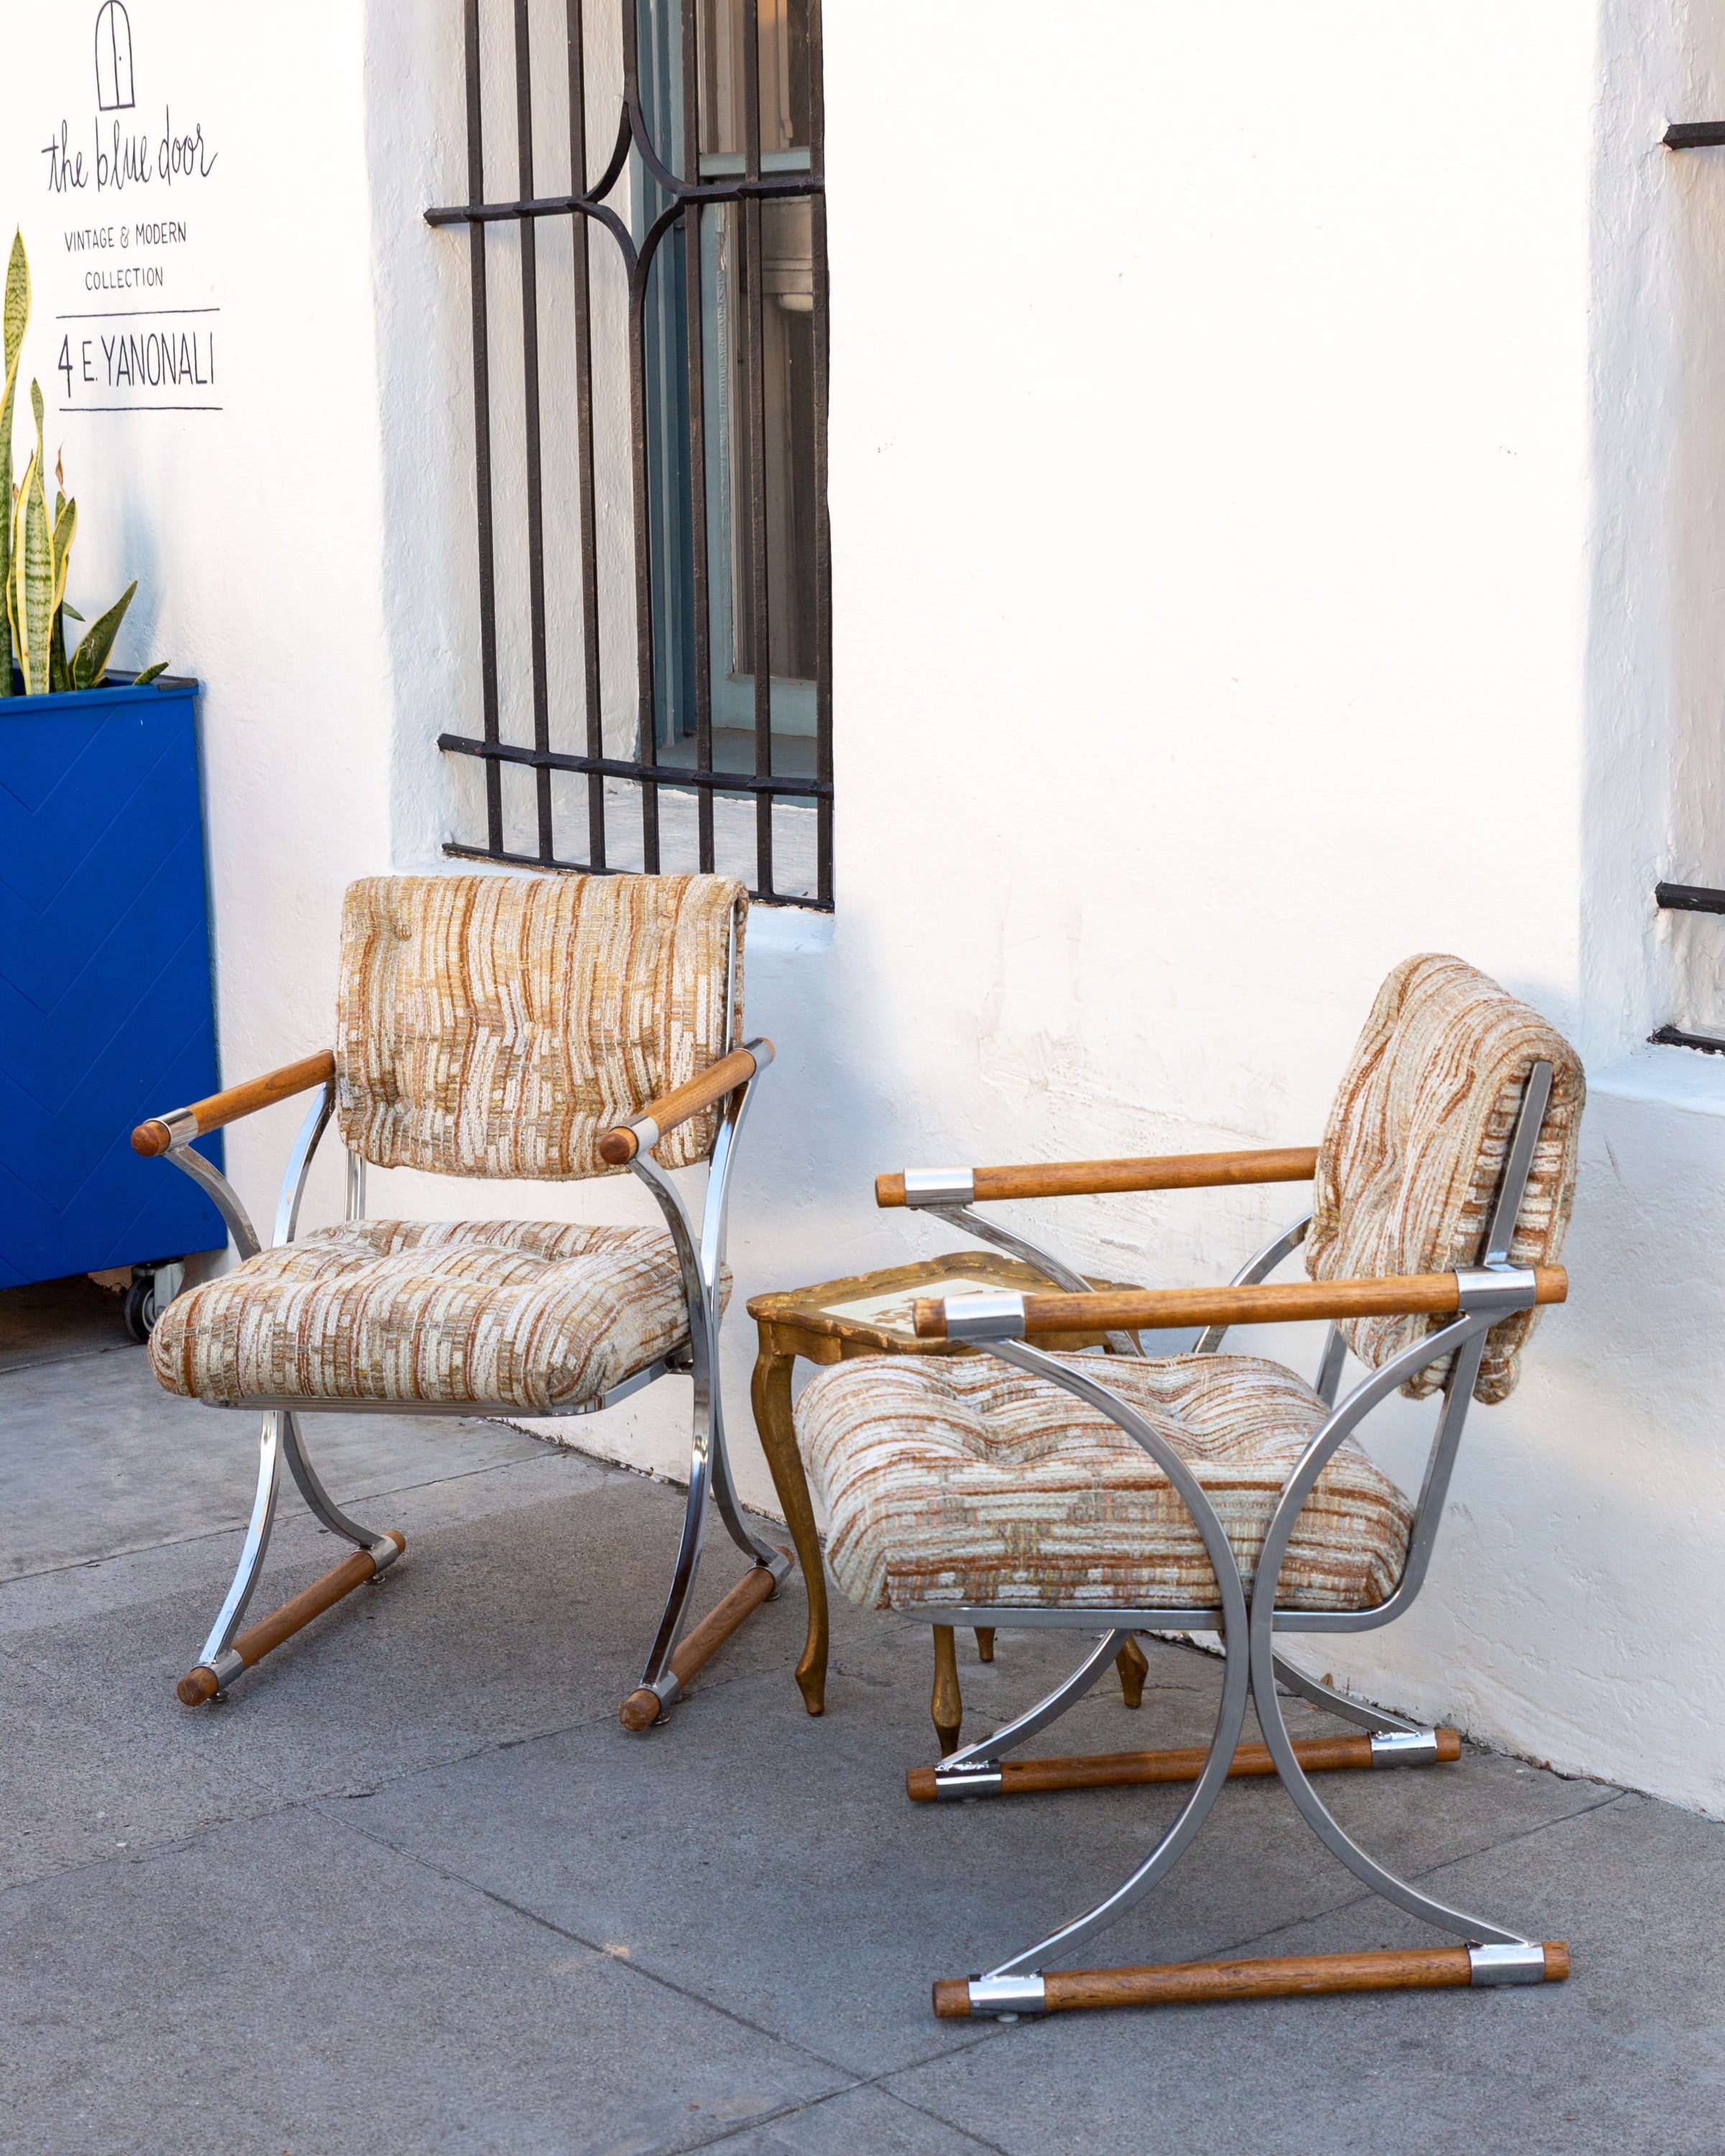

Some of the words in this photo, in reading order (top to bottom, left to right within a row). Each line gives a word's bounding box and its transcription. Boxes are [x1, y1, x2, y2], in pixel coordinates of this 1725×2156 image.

[42, 119, 88, 192] the
[96, 116, 152, 192] blue
[159, 104, 218, 186] door
[65, 227, 114, 252] VINTAGE
[120, 227, 130, 248] &
[136, 221, 187, 247] MODERN
[85, 267, 163, 290] COLLECTION
[58, 334, 73, 398] 4
[101, 332, 214, 387] YANONALI
